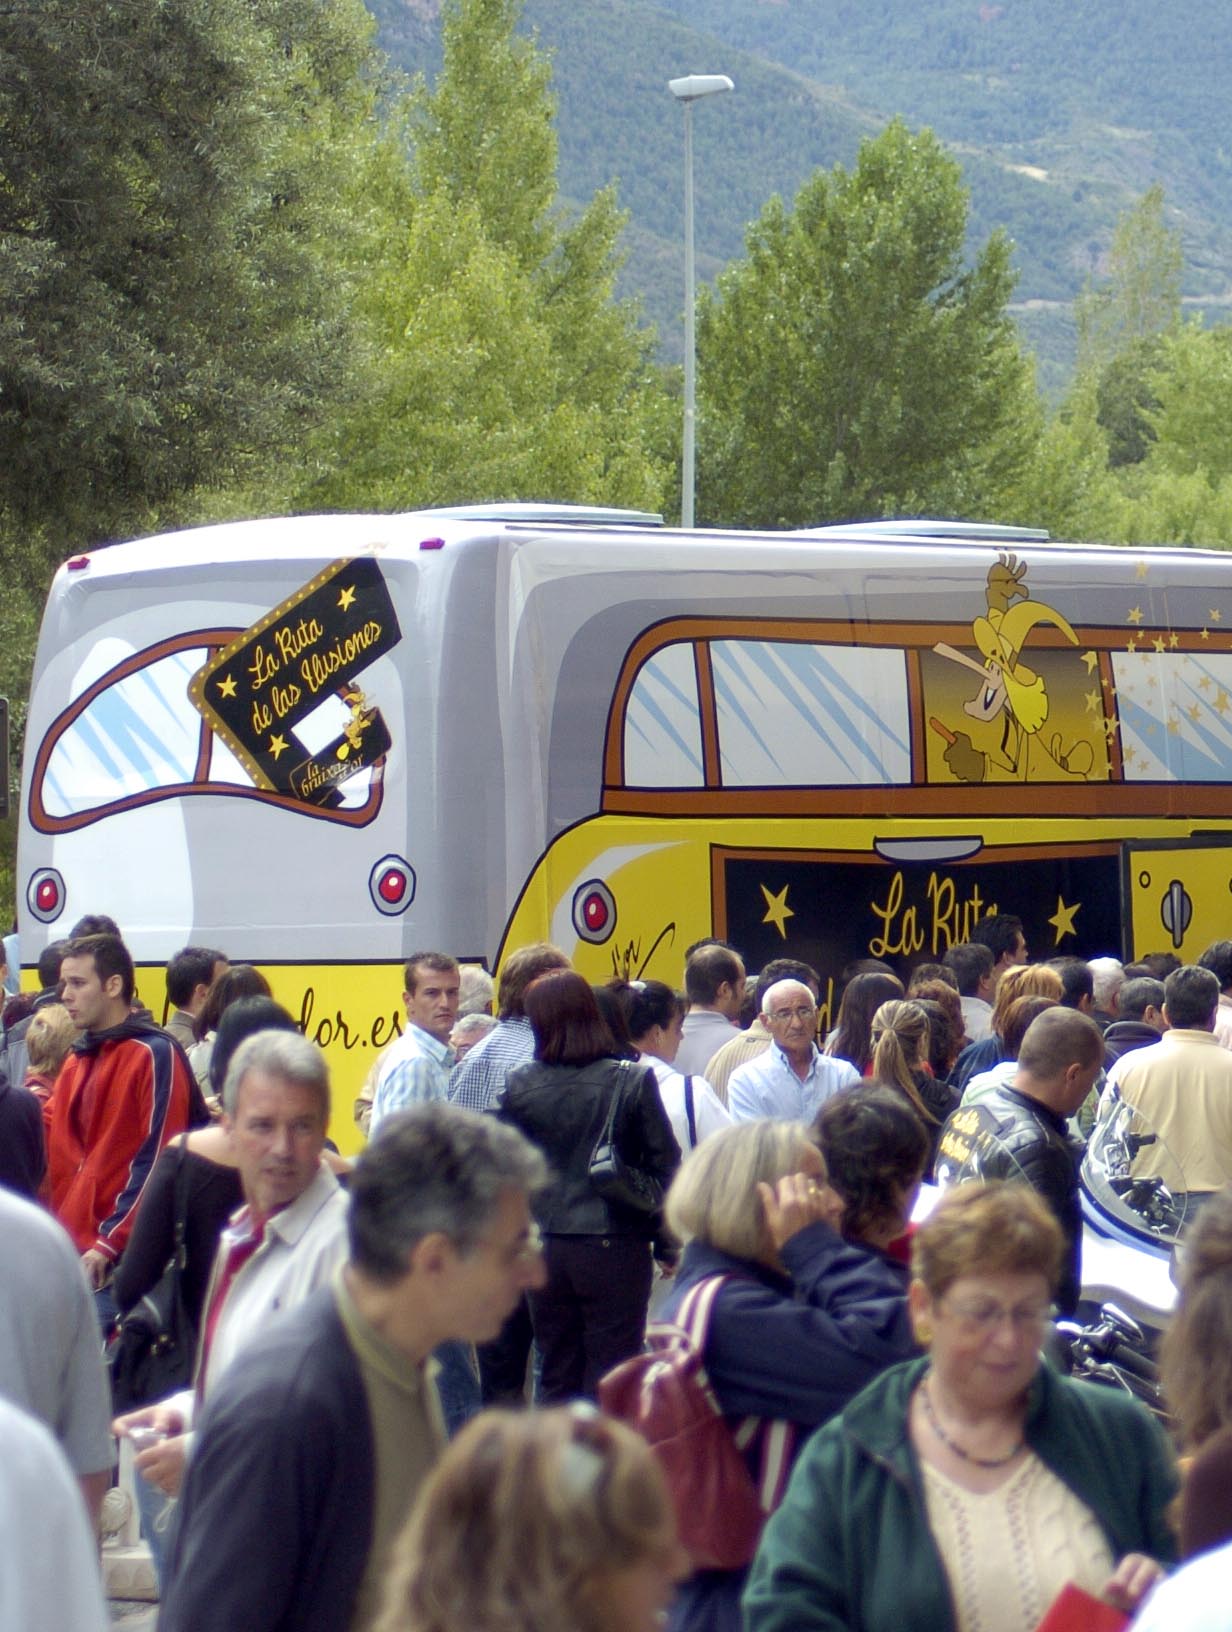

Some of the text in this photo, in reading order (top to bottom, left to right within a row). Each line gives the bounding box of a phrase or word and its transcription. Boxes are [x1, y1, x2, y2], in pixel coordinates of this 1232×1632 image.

[248, 618, 324, 690] La Ruta
[252, 621, 382, 735] de las Ilusiones
[869, 871, 925, 958] La
